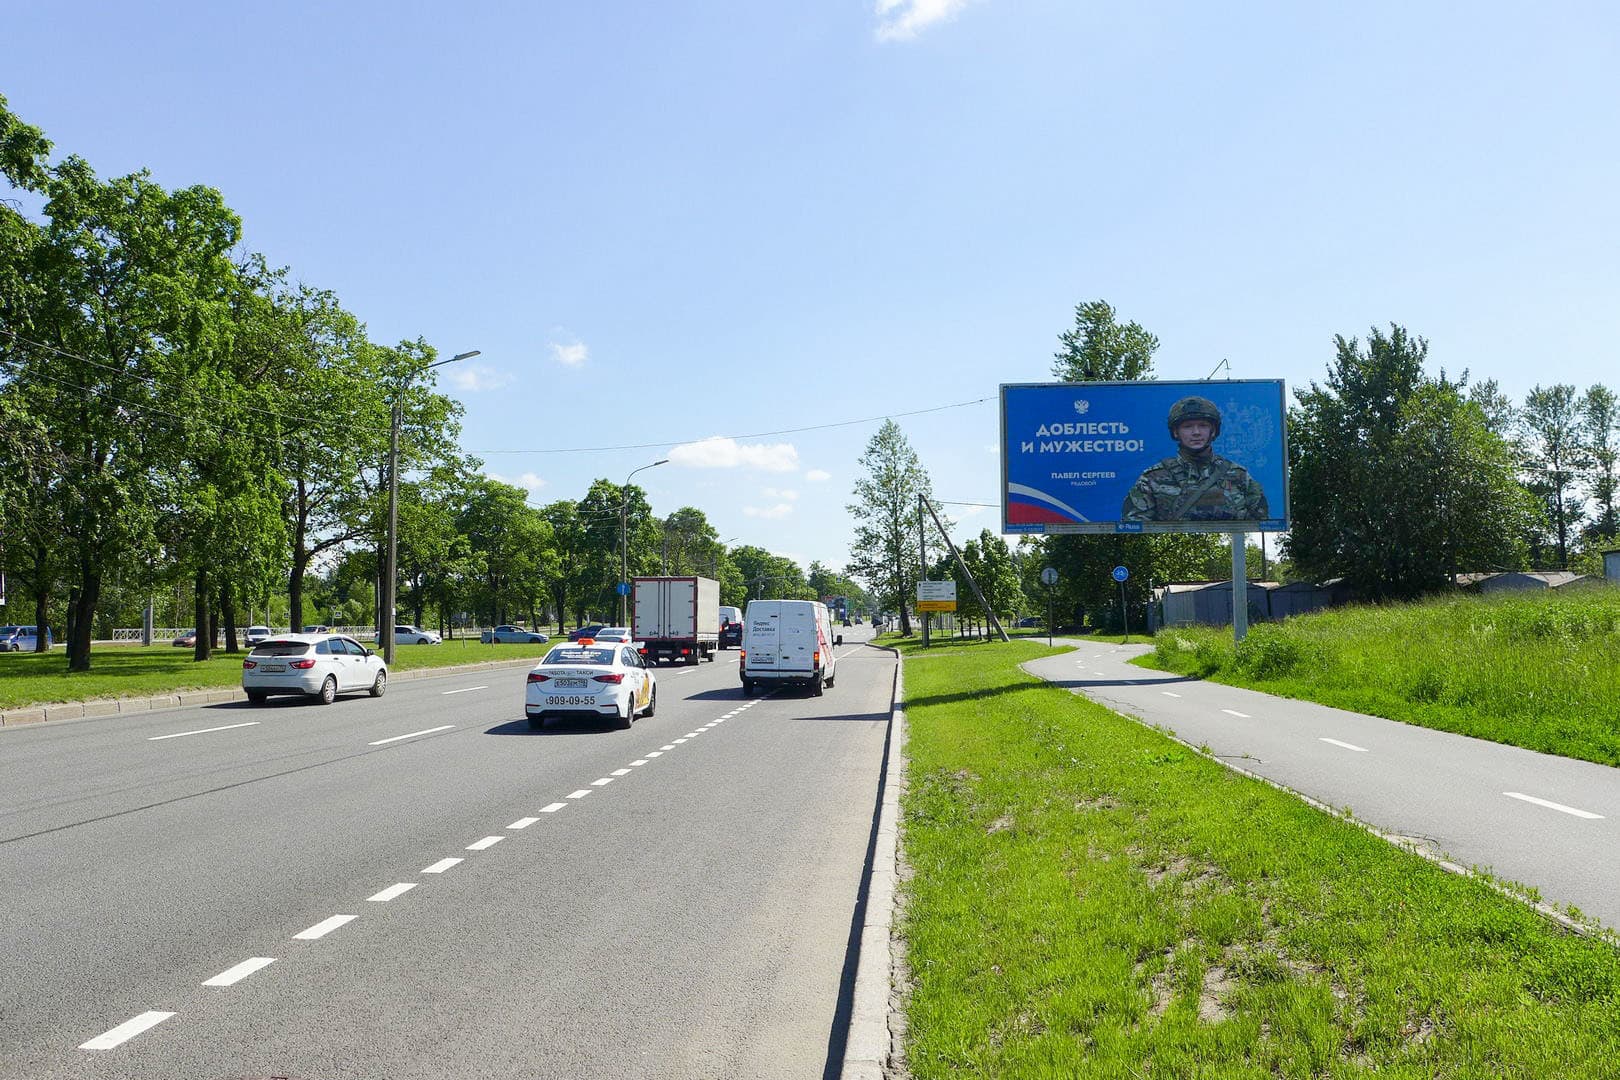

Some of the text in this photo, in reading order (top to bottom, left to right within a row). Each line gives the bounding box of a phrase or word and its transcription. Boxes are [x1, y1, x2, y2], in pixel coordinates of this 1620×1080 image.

[1035, 422, 1129, 437] ДОБЛЕСТЬ
[1021, 439, 1144, 453] И МУЖЕСТВО!
[1081, 471, 1116, 479] СЕРГЕЕВ
[549, 695, 595, 705] 909-09-55
